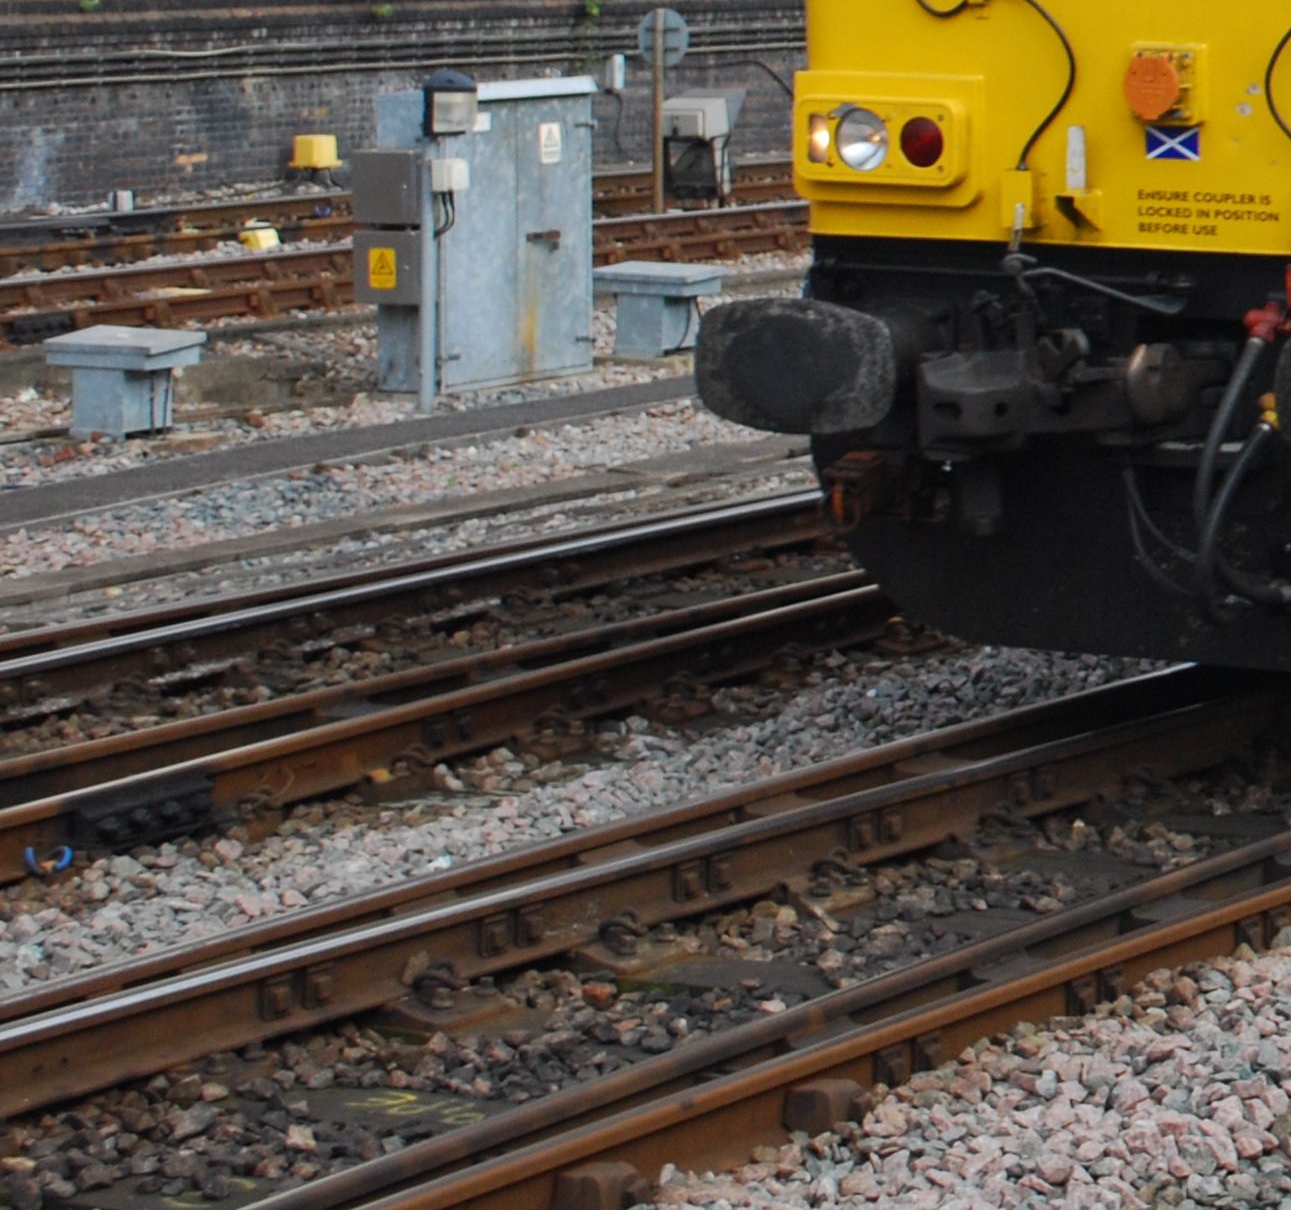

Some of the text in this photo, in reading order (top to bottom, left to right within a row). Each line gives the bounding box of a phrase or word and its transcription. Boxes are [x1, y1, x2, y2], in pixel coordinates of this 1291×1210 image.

[1137, 189, 1272, 206] ENSURE COUPLER IS
[1137, 205, 1280, 222] LOCKED IN POSITION
[1138, 221, 1218, 236] BEFORE USE
